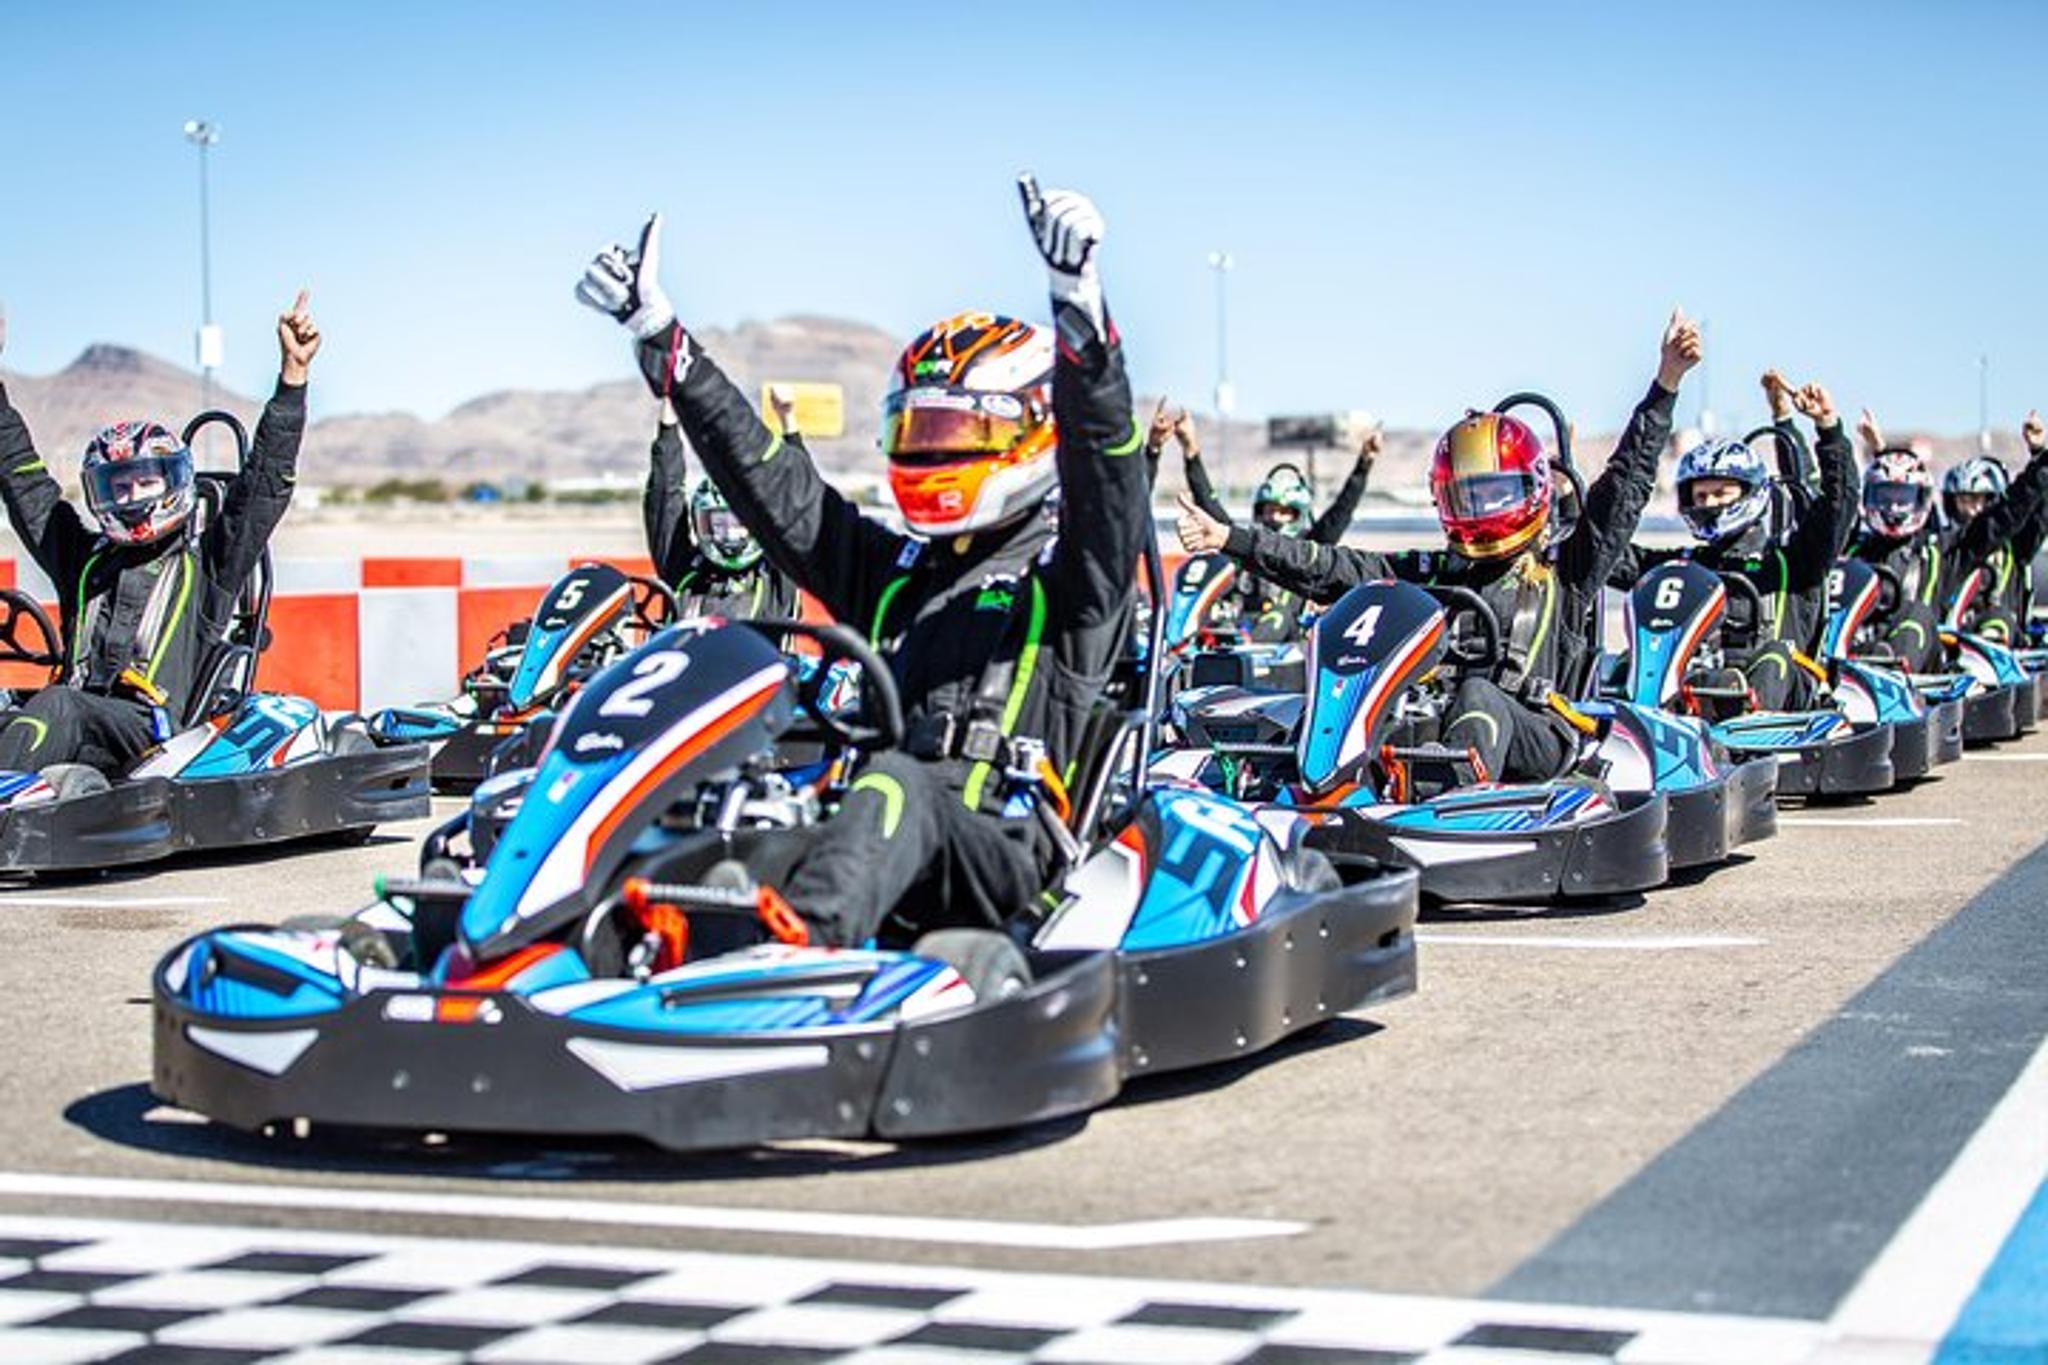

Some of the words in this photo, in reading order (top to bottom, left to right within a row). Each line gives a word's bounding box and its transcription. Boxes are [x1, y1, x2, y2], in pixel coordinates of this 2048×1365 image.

[555, 579, 589, 609] 5
[1654, 576, 1684, 610] 6
[1343, 604, 1383, 647] 4
[598, 648, 691, 717] 2
